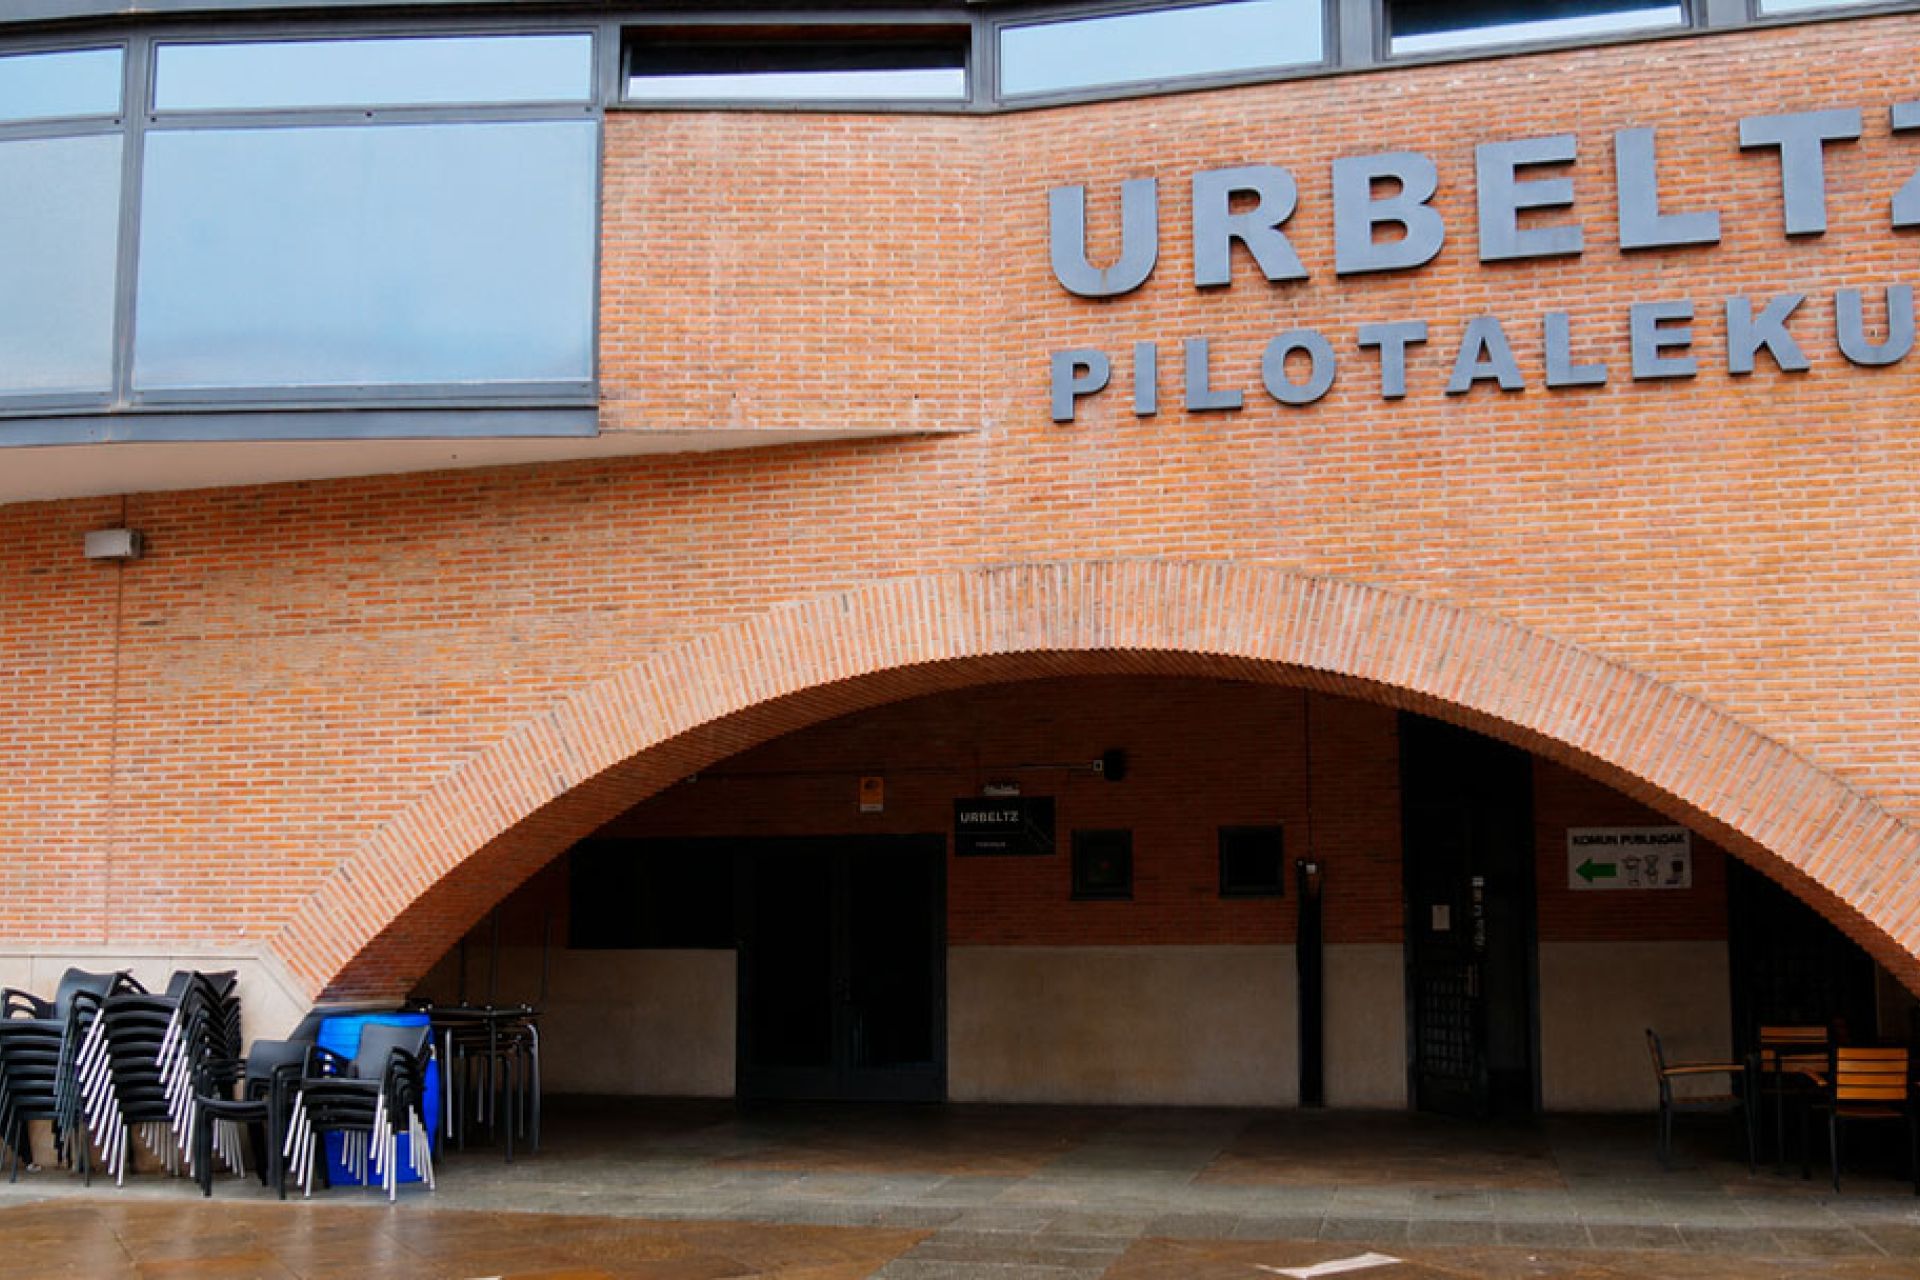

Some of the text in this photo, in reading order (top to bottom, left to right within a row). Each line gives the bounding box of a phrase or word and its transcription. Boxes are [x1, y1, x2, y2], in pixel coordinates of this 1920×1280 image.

[1048, 101, 1920, 298] URBELT
[1050, 285, 1915, 424] PILOTALEKU
[960, 810, 1020, 823] URBELTZ
[1572, 834, 1619, 846] KOMUN
